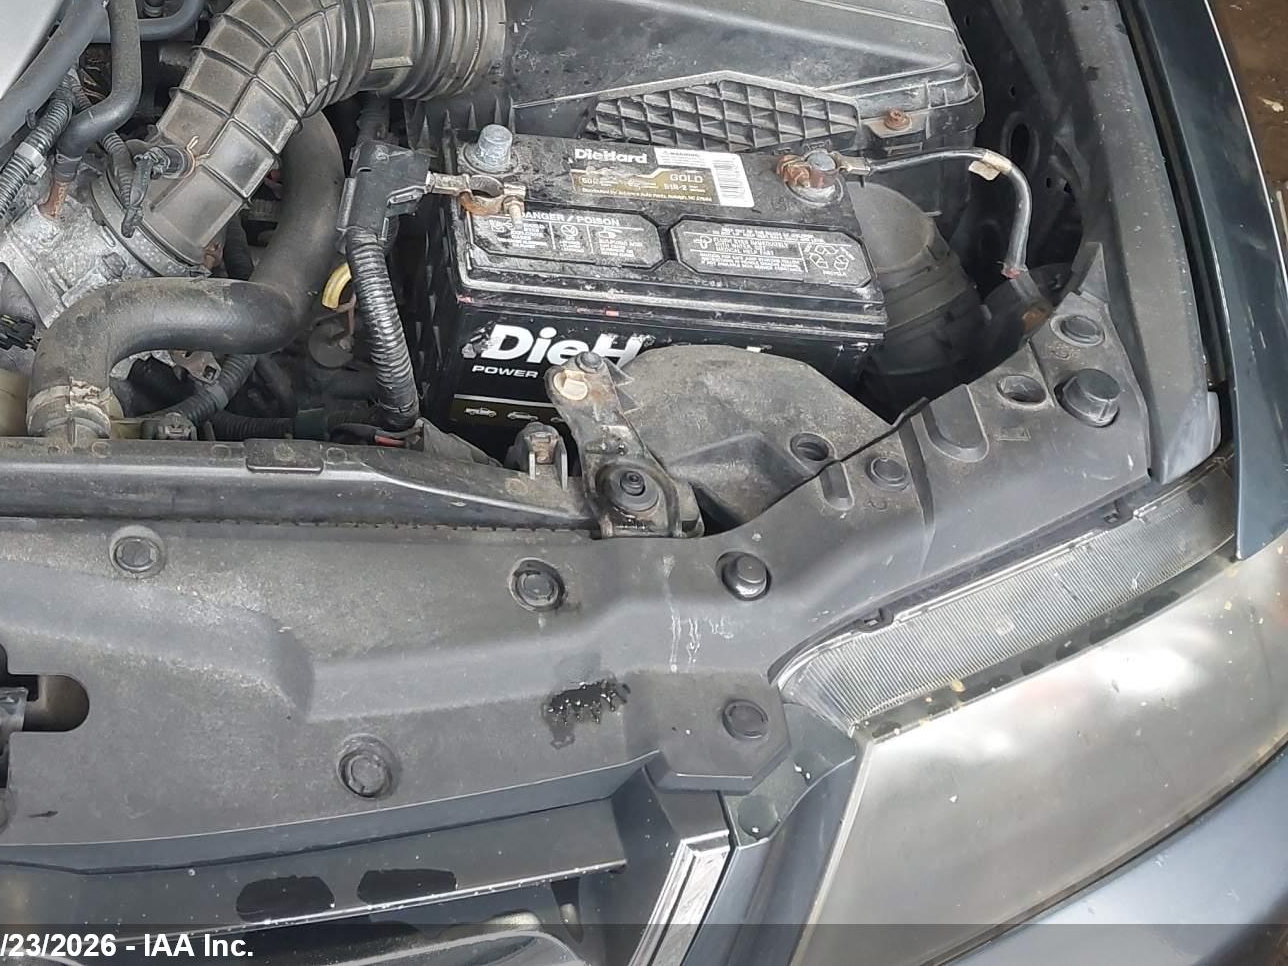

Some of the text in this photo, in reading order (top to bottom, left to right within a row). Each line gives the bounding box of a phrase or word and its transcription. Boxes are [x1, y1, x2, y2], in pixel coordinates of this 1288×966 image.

[574, 147, 648, 165] DieHard
[669, 173, 704, 184] GOLD
[576, 215, 620, 227] POISON
[471, 365, 539, 379] POWER
